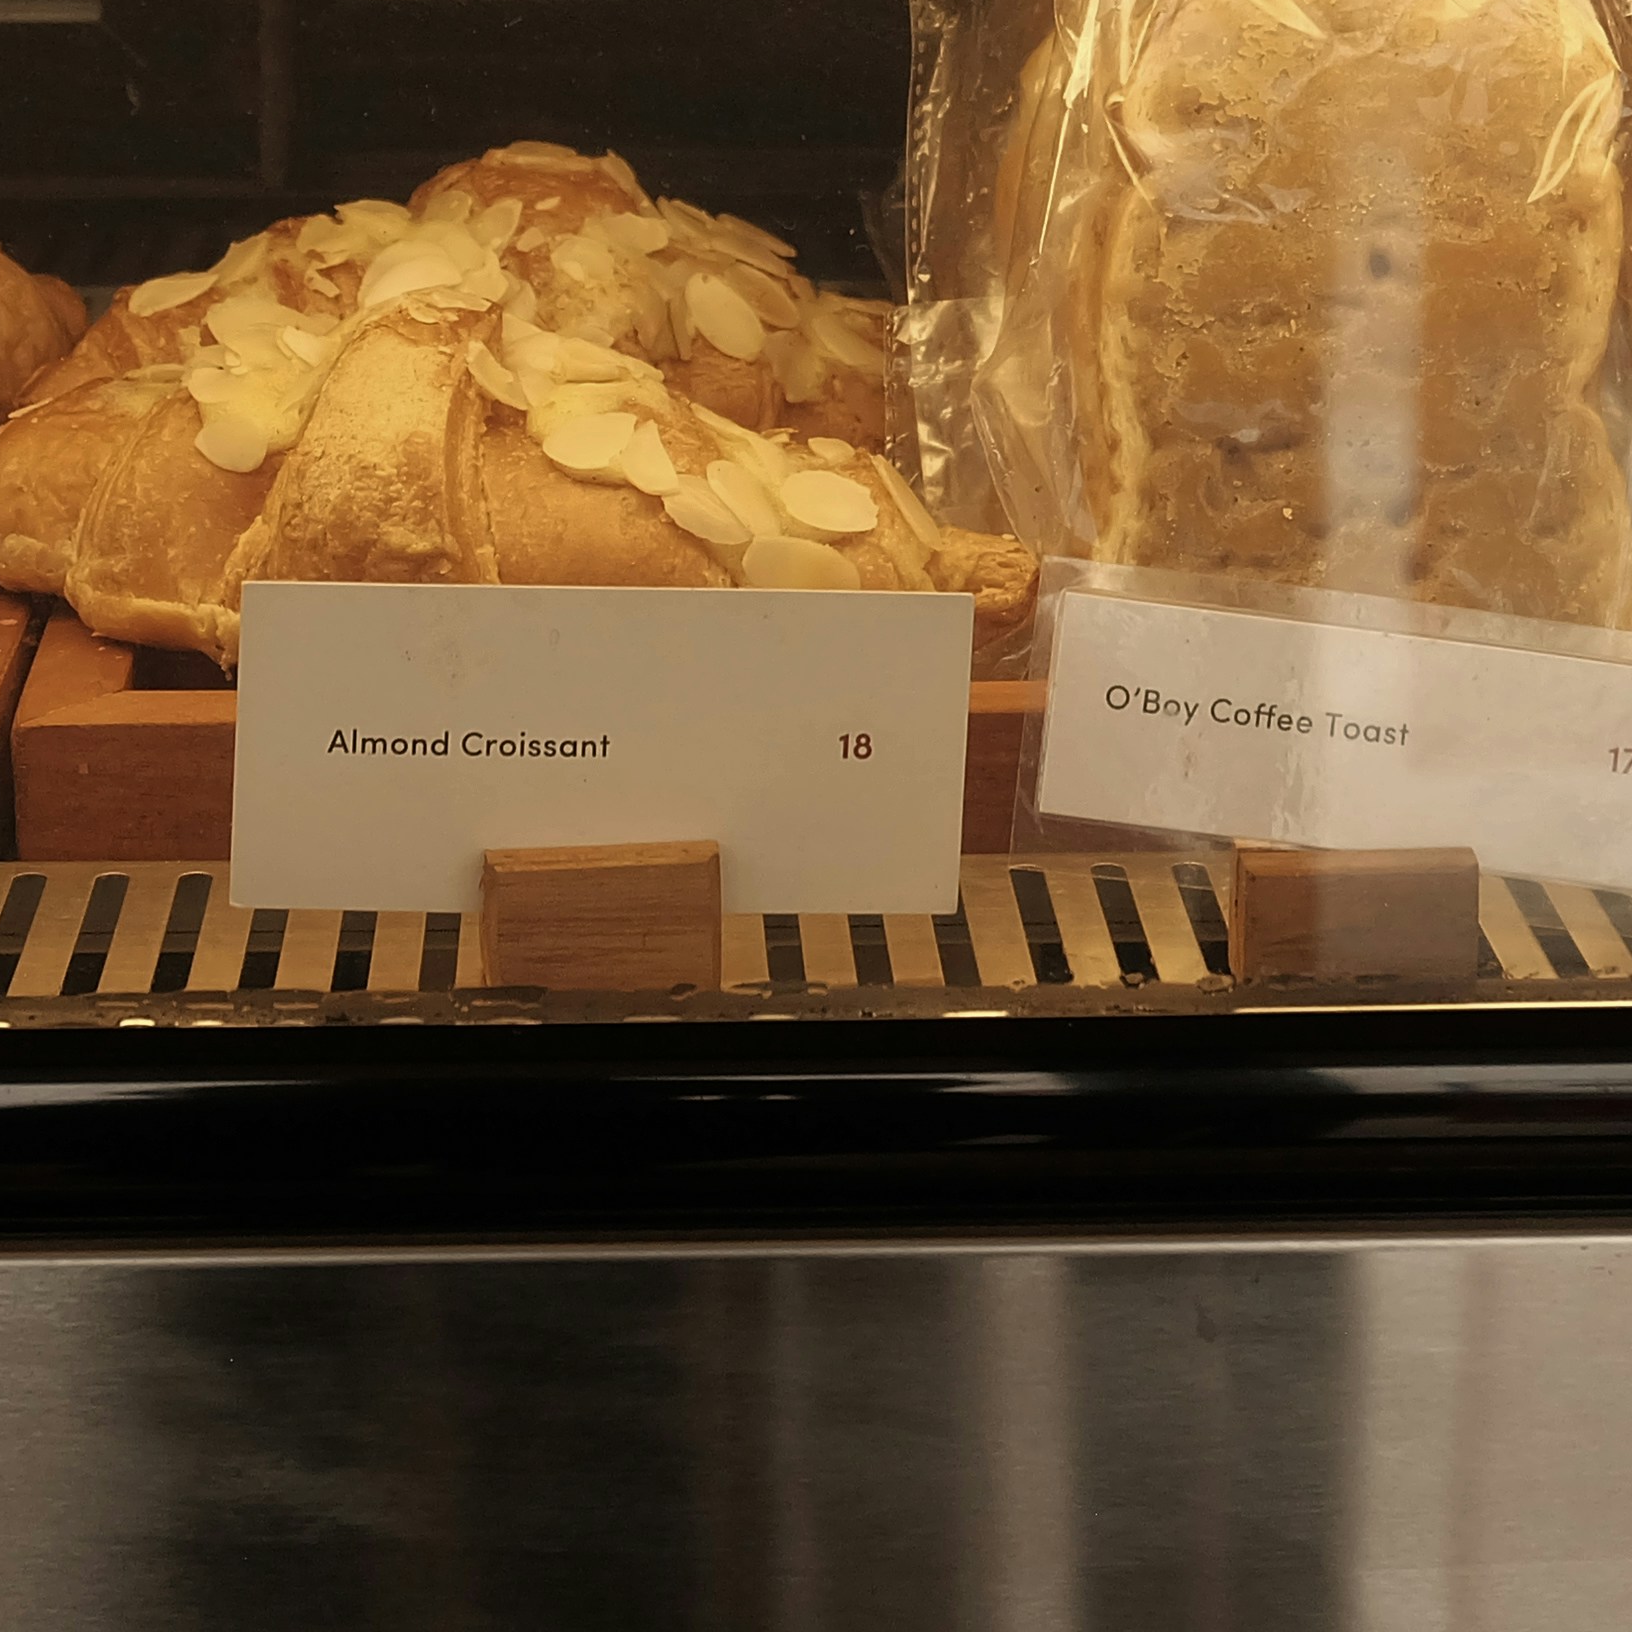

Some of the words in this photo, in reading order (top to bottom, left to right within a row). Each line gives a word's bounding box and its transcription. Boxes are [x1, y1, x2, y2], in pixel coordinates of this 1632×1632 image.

[1210, 698, 1313, 734] Coffee
[1325, 712, 1410, 746] Toast
[327, 728, 449, 756] Almond
[461, 731, 611, 758] Croissant
[838, 733, 873, 760] 18
